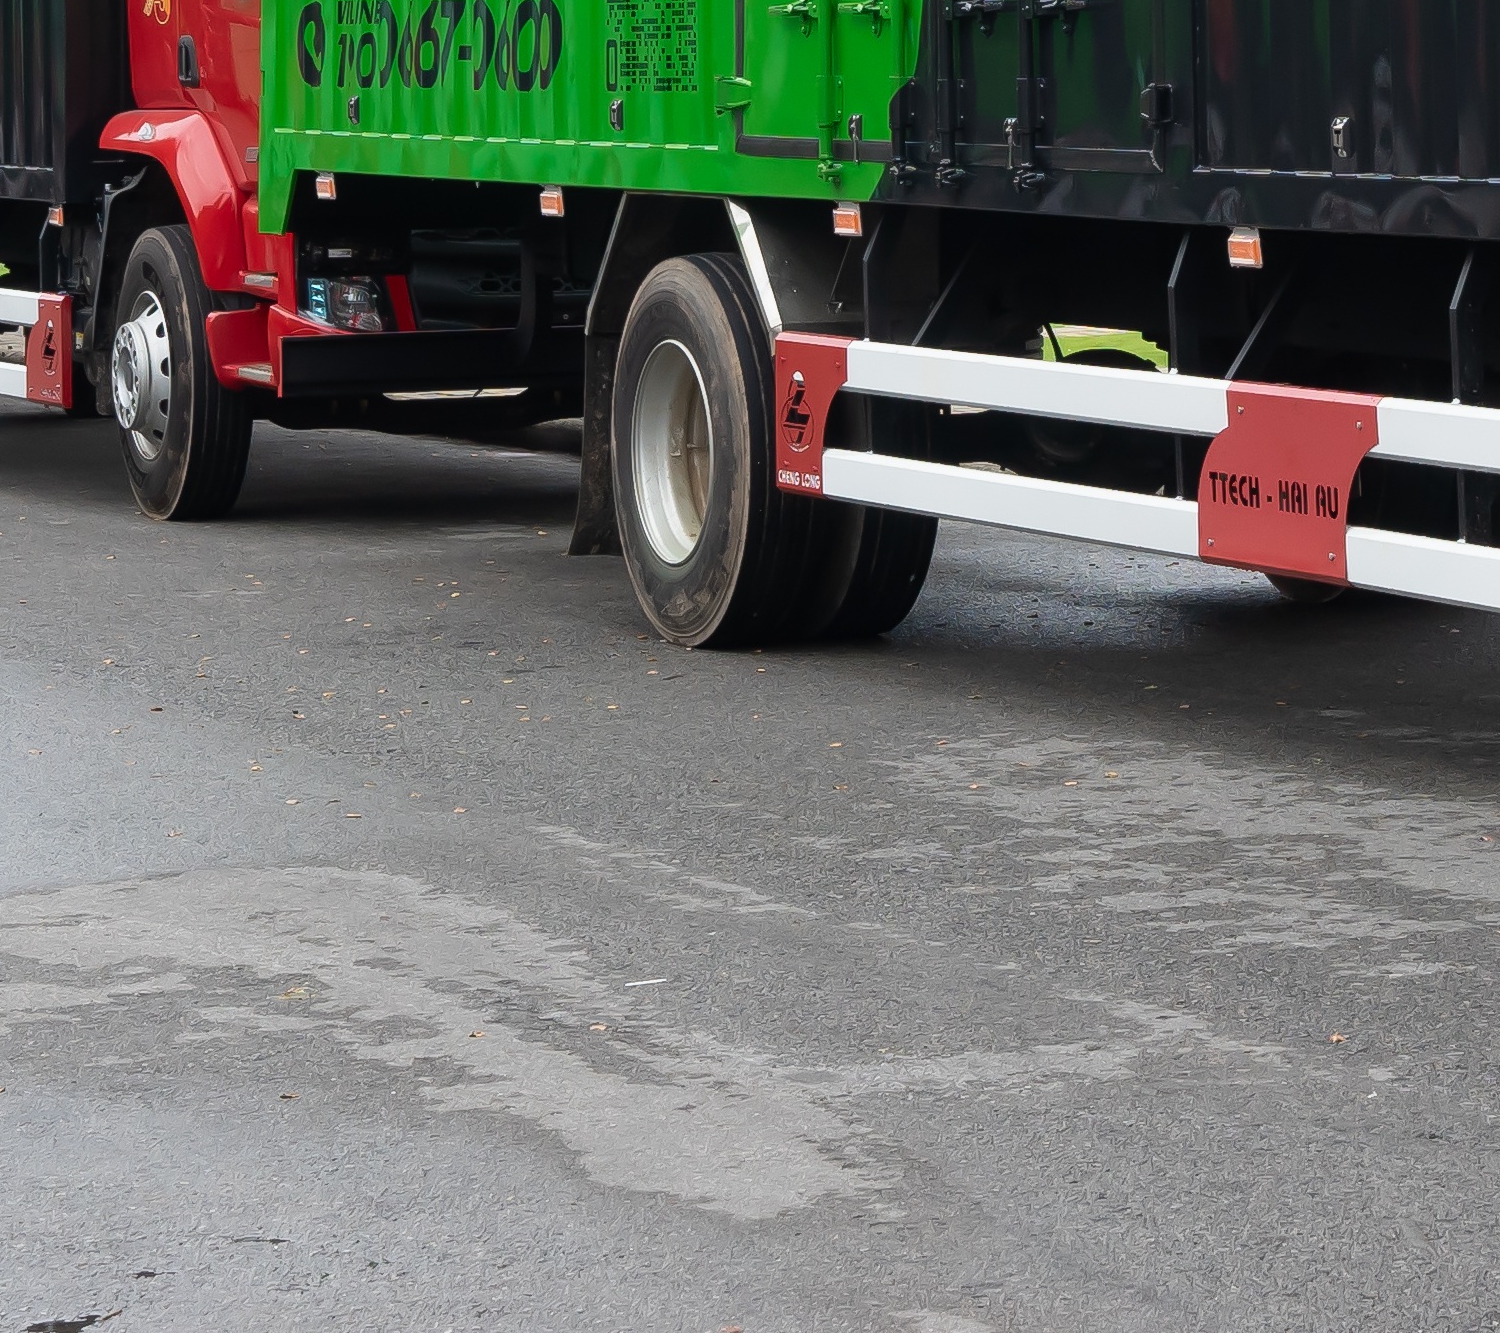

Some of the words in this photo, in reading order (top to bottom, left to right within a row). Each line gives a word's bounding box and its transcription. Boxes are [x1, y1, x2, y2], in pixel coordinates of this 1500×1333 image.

[801, 472, 821, 490] LONG
[1208, 470, 1261, 509] TTECH
[1278, 479, 1309, 516] HAI
[1315, 483, 1339, 520] AU
